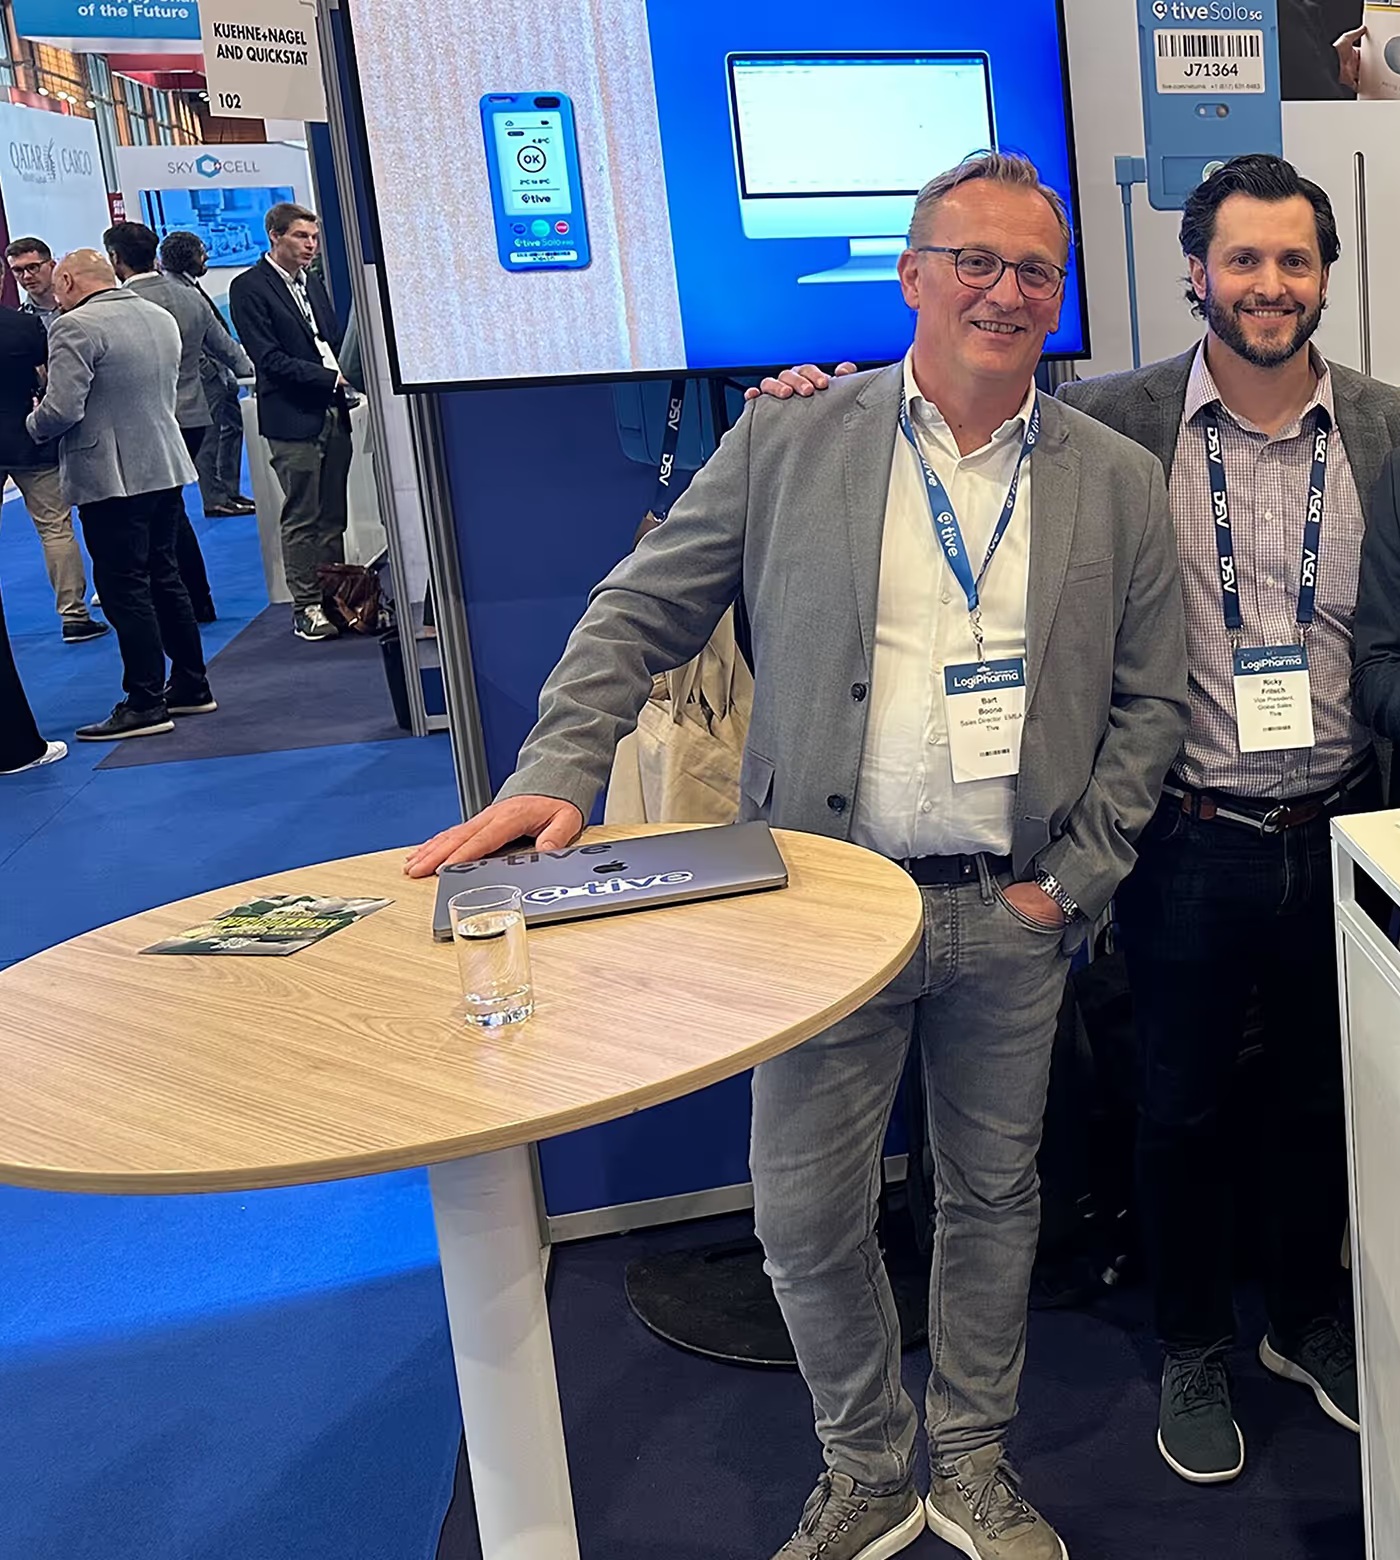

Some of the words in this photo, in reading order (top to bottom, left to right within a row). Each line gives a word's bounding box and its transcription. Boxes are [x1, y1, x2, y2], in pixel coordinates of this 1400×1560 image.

[78, 4, 95, 17] of
[100, 4, 128, 17] the
[133, 5, 189, 18] Future
[213, 22, 307, 45] KUEHNE+NAGEL
[217, 44, 243, 60] AND
[246, 46, 308, 65] QUICKSTAT
[1184, 63, 1239, 77] J71364
[218, 93, 241, 109] 102
[9, 141, 46, 175] QATAR
[167, 161, 194, 174] SKY
[223, 160, 260, 173] CELL
[523, 154, 540, 164] OK
[531, 195, 551, 204] tive
[668, 398, 682, 431] DSV
[1207, 427, 1222, 464] DSV
[1315, 427, 1328, 463] DSV
[659, 454, 674, 487] DSV
[1213, 490, 1229, 529] DSV
[1307, 486, 1323, 523] DSV
[941, 524, 958, 557] tive
[1220, 556, 1237, 594] DSV
[1302, 549, 1317, 587] DSV
[1241, 657, 1302, 671] LogiPharma
[954, 672, 1019, 689] LogiPharma
[981, 696, 998, 705] Bart
[582, 872, 692, 896] tive
